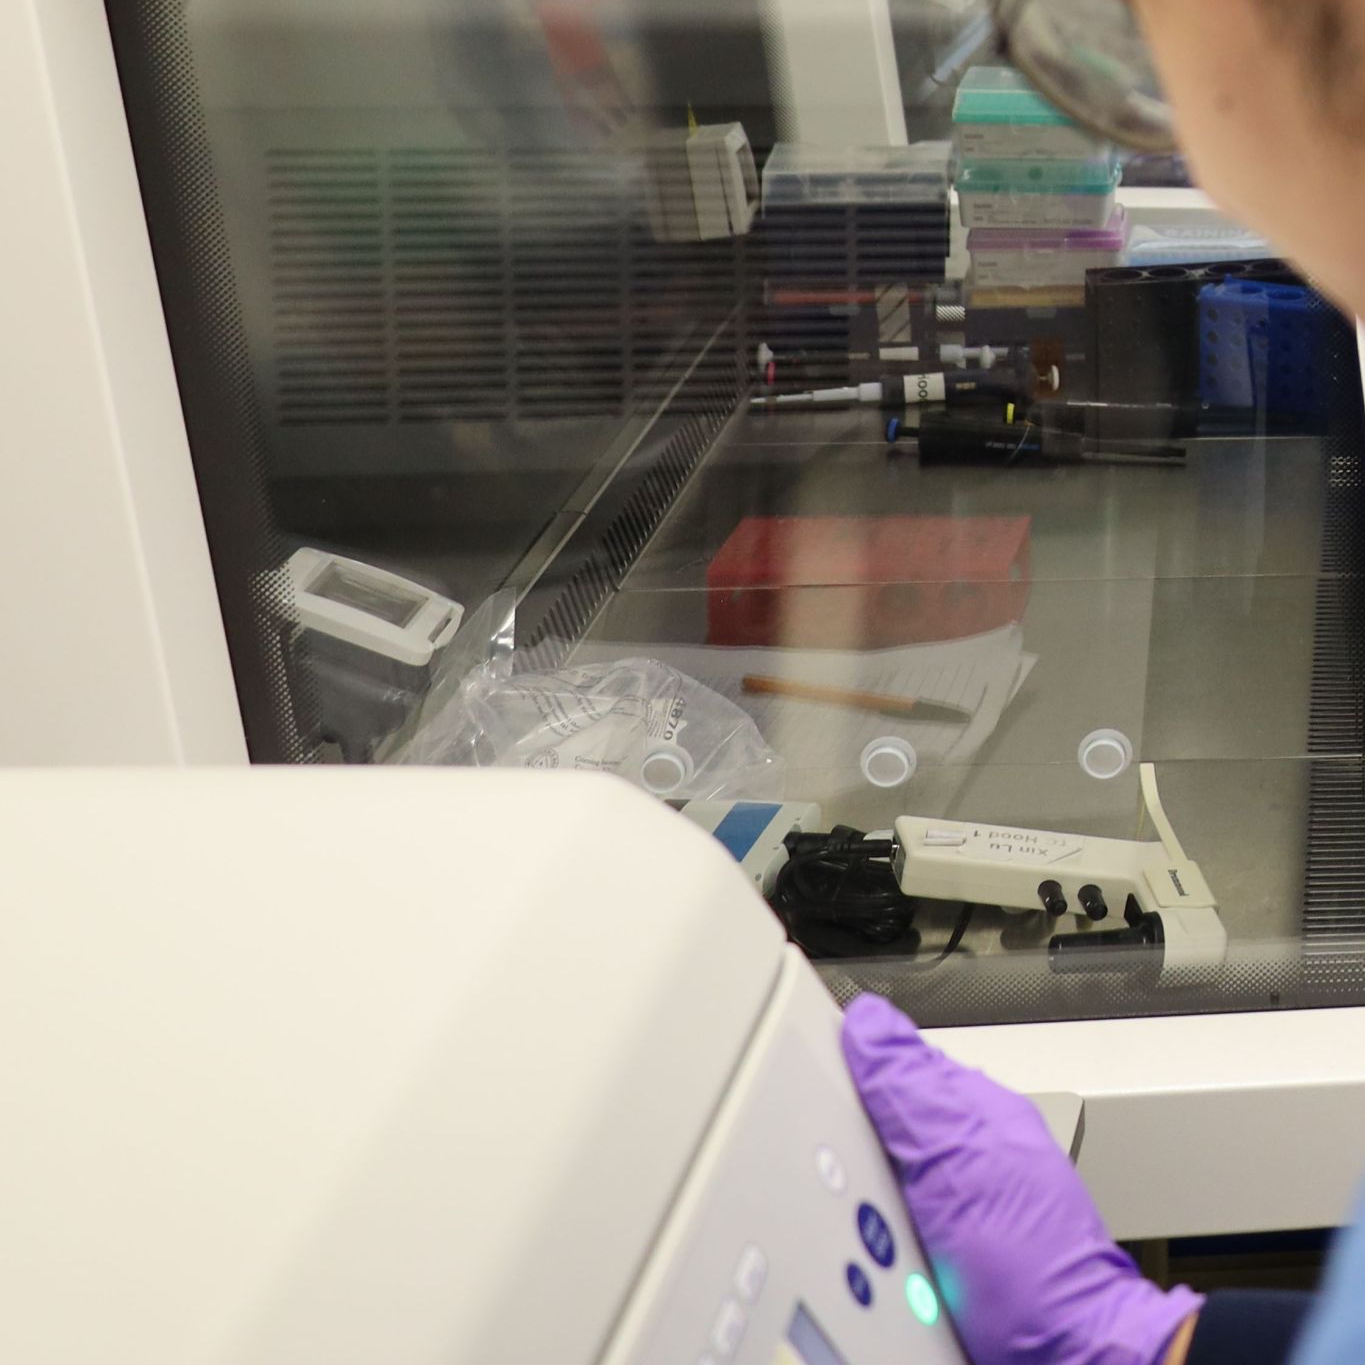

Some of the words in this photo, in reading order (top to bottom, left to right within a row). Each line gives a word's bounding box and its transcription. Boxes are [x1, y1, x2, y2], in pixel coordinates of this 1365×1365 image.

[988, 830, 1039, 844] Hood
[989, 842, 1013, 854] Lu
[1018, 845, 1049, 858] Xin
